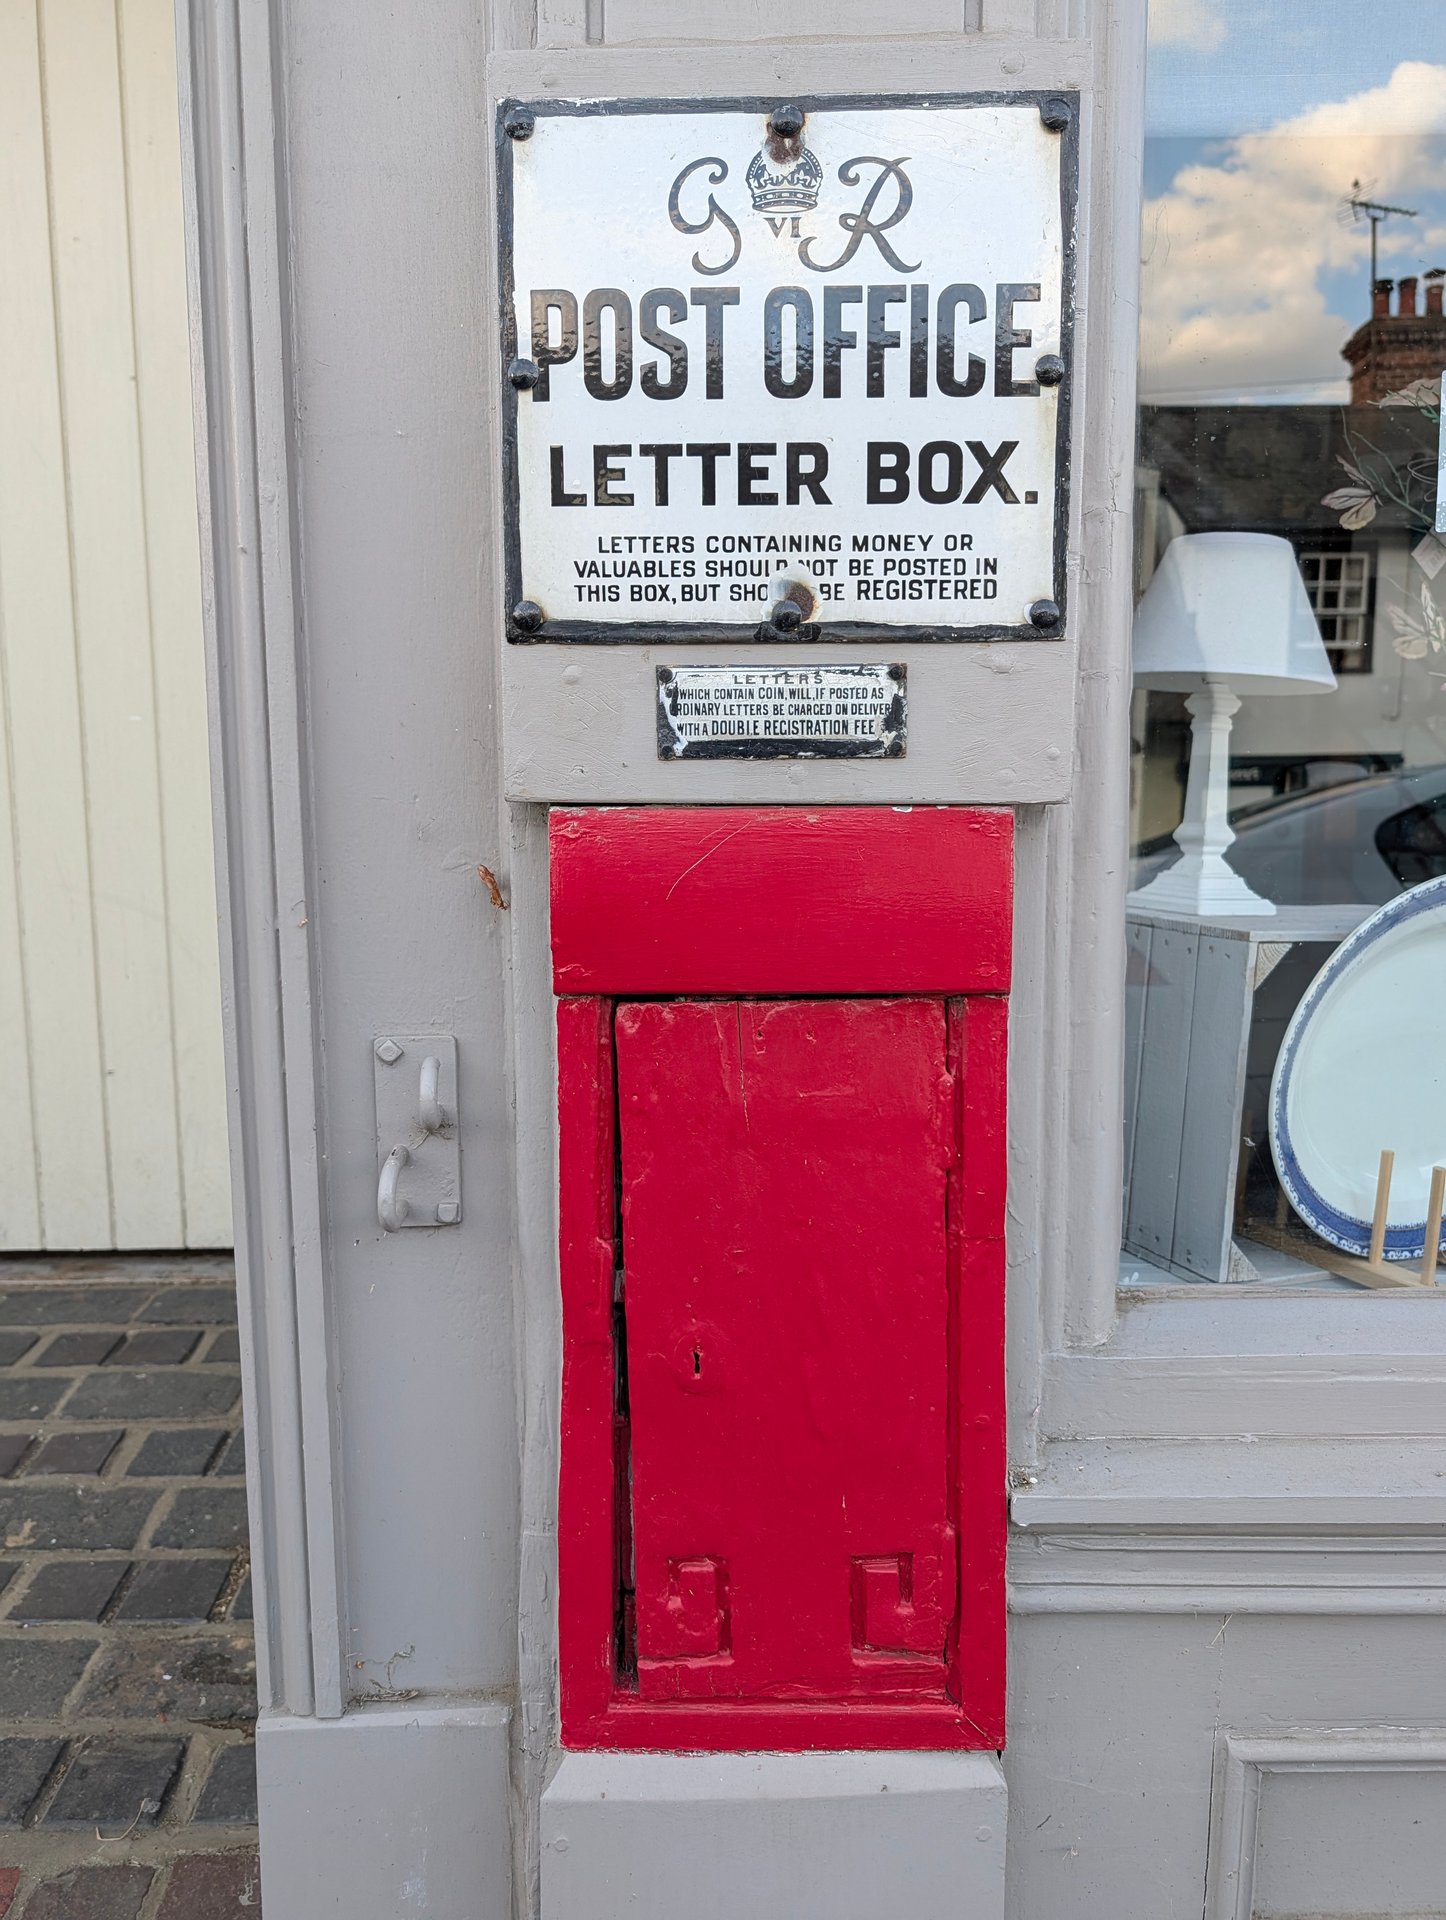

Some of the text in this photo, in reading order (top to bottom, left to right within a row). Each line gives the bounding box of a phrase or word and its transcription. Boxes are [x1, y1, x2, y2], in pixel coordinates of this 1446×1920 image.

[763, 216, 802, 239] VI
[797, 155, 922, 274] R
[529, 282, 1041, 402] POST OFFICE
[549, 439, 1039, 507] LETTER BOX.
[598, 533, 974, 554] LETTERS CONTAINING MONEY OR
[573, 560, 696, 578] VALUABLES
[848, 558, 875, 577] BE
[883, 558, 967, 577] POSTED
[976, 557, 998, 576] IN
[573, 584, 621, 603] THIS
[681, 583, 721, 602] BUT
[856, 578, 998, 601] REGISTERED
[733, 673, 823, 685] LETTERS
[680, 688, 710, 700] WHICH
[714, 688, 755, 700] CONTAIN
[829, 687, 868, 700] POSTED
[871, 687, 884, 699] AS
[723, 703, 769, 716] LETTERS
[773, 703, 784, 716] BE
[788, 703, 832, 716] CHARGED
[835, 703, 848, 716] ON
[677, 719, 876, 737] WITH A DOUBLE REGISTRATION FEE
